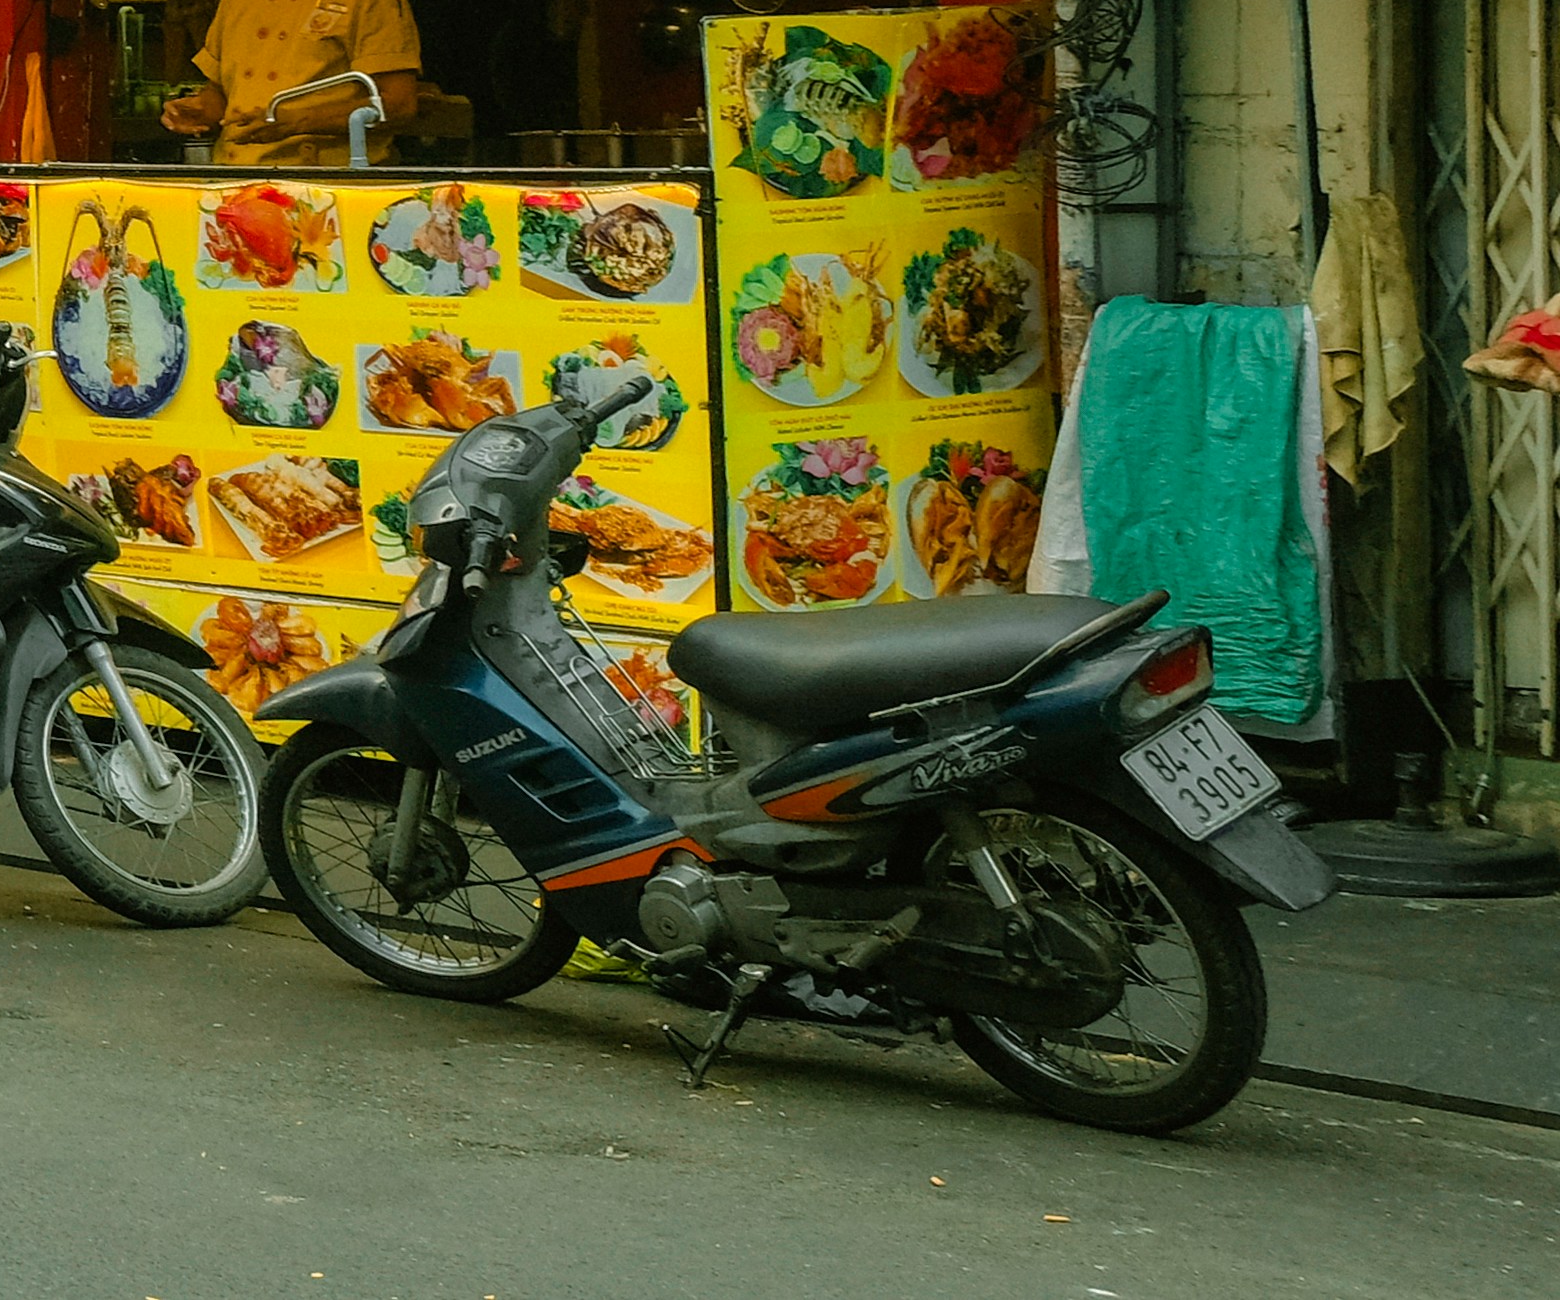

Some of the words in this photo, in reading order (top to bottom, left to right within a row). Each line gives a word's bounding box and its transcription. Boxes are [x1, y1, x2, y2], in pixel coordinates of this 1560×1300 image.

[22, 534, 69, 554] HONDA
[455, 727, 528, 765] SUZUKI
[909, 751, 988, 792] Viva
[1178, 754, 1261, 822] 3905
